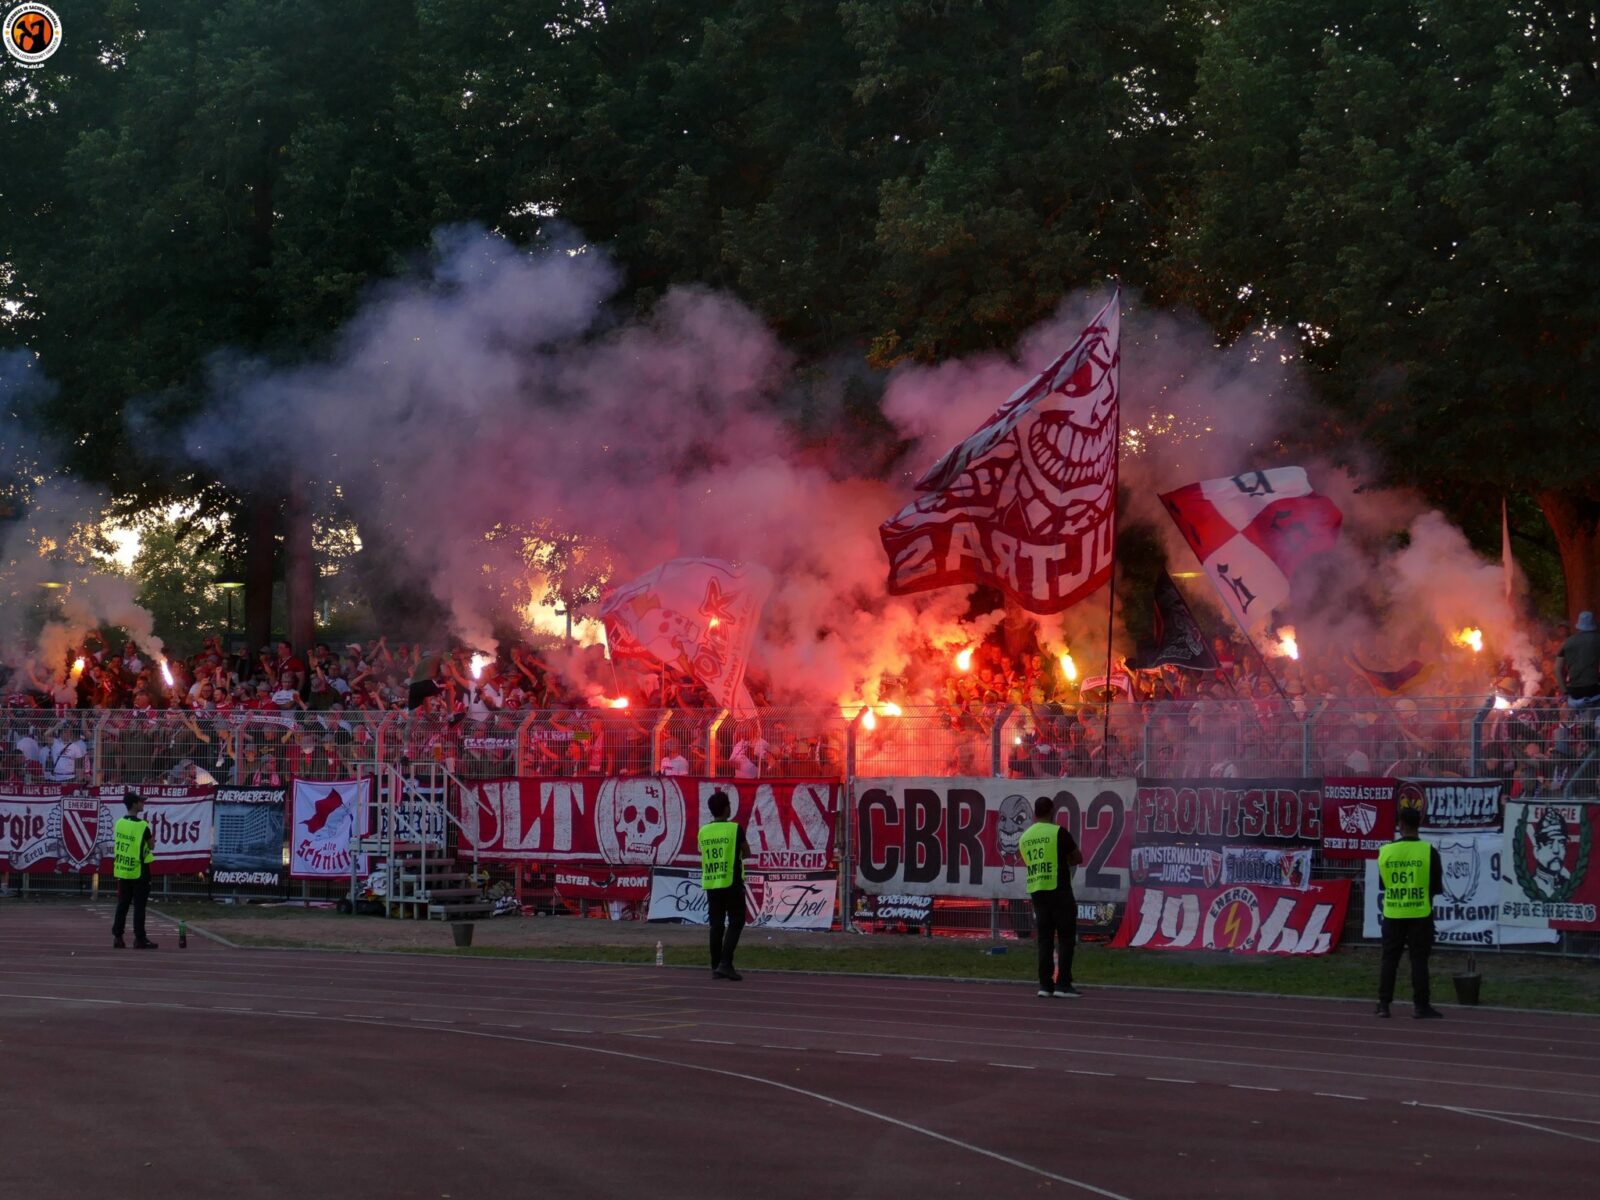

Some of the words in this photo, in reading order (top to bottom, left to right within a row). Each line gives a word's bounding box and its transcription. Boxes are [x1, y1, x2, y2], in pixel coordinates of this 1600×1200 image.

[43, 785, 62, 795] EINE
[99, 785, 125, 795] SACHE
[143, 787, 160, 795] WIR
[162, 787, 188, 797] LEBEN
[215, 789, 286, 803] ENERGIEBEZIRK
[1324, 784, 1394, 800] GROSSRÄSCHEN
[1425, 785, 1502, 817] VERBOTEN
[1136, 787, 1321, 840] FRONTSIDE
[700, 837, 730, 846] STEWARD
[857, 788, 986, 885] CBR
[1323, 837, 1347, 849] STEHT
[1348, 838, 1359, 849] ZU
[116, 841, 130, 853] 167
[706, 847, 724, 859] 180
[758, 851, 826, 870] ENERGIE
[1027, 848, 1044, 861] 126
[1144, 846, 1211, 866] FINSTERWALDER
[555, 873, 590, 886] ELSTER
[617, 876, 649, 888] FRONT
[1160, 864, 1192, 883] JUNGS
[1391, 871, 1414, 884] 061
[1386, 887, 1424, 900] EMPIRE
[1209, 889, 1258, 918] ENERGIE
[877, 907, 930, 920] COMPANY
[1077, 904, 1097, 920] RKE
